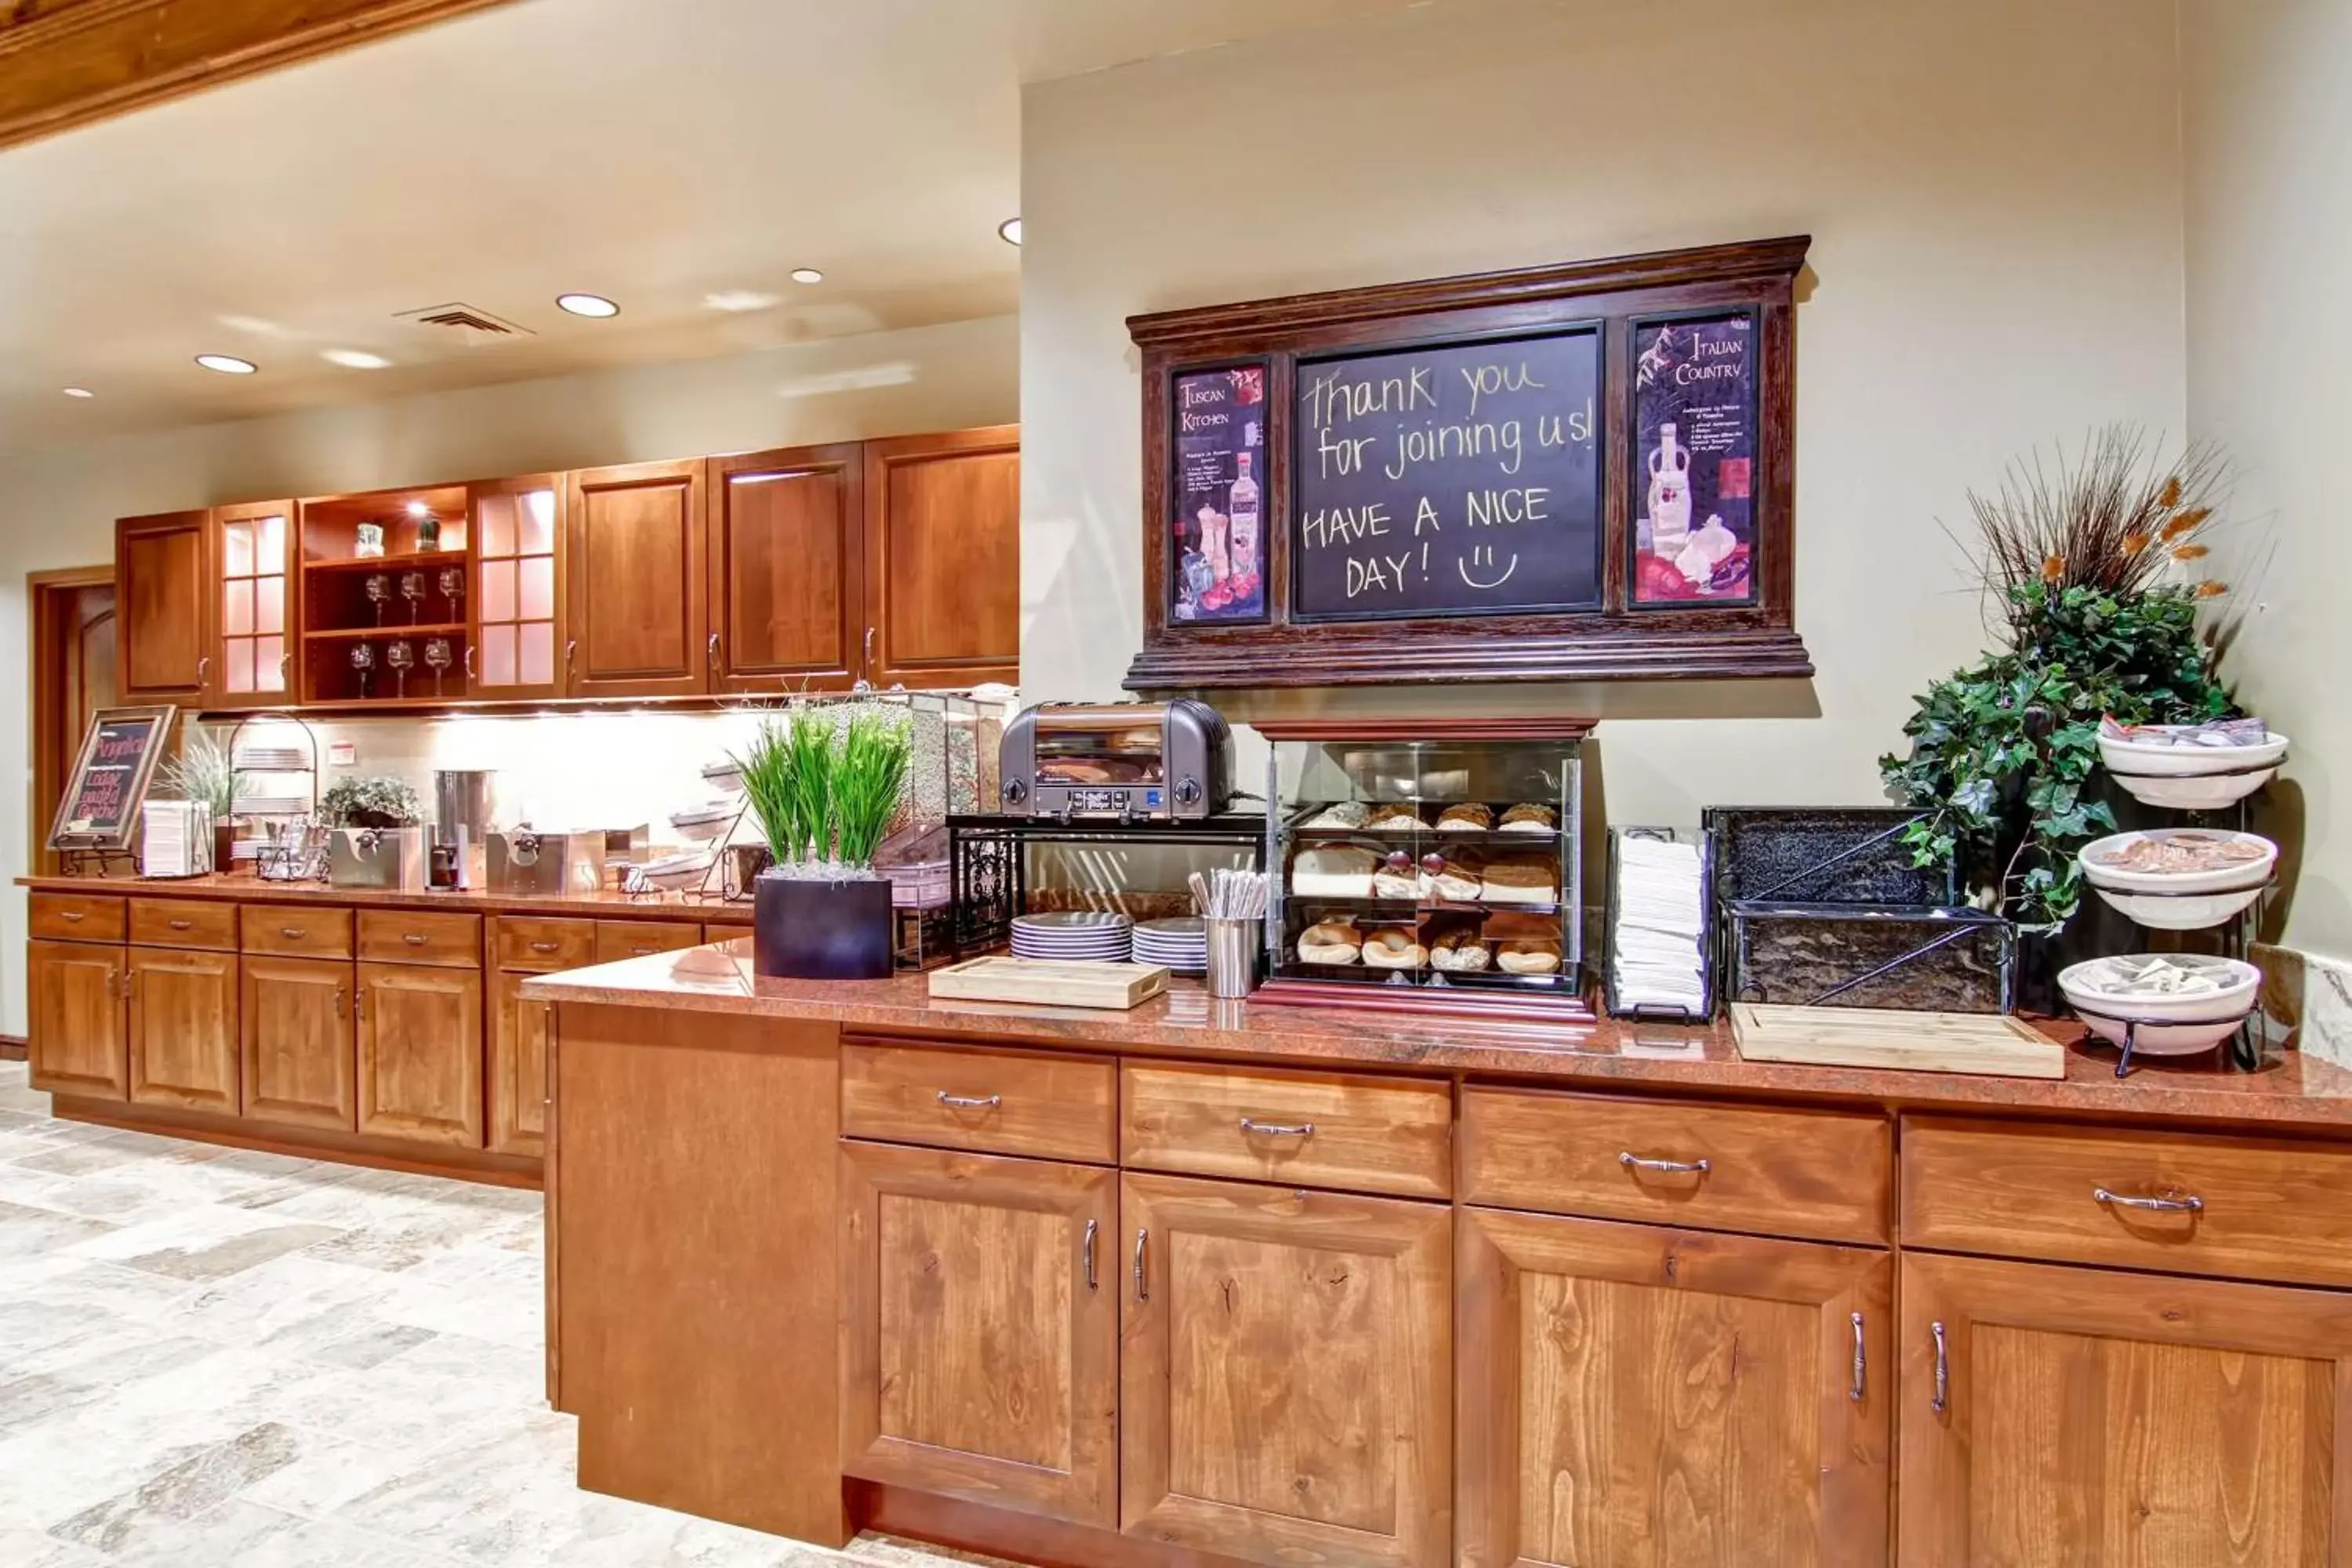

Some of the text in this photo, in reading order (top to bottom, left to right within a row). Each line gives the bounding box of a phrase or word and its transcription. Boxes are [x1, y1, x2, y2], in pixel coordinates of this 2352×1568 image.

[1302, 361, 1545, 428] Thank you
[1318, 396, 1594, 480] for joining us!
[1302, 488, 1551, 549] HAVE A NICE
[1346, 543, 1429, 598] DAY!
